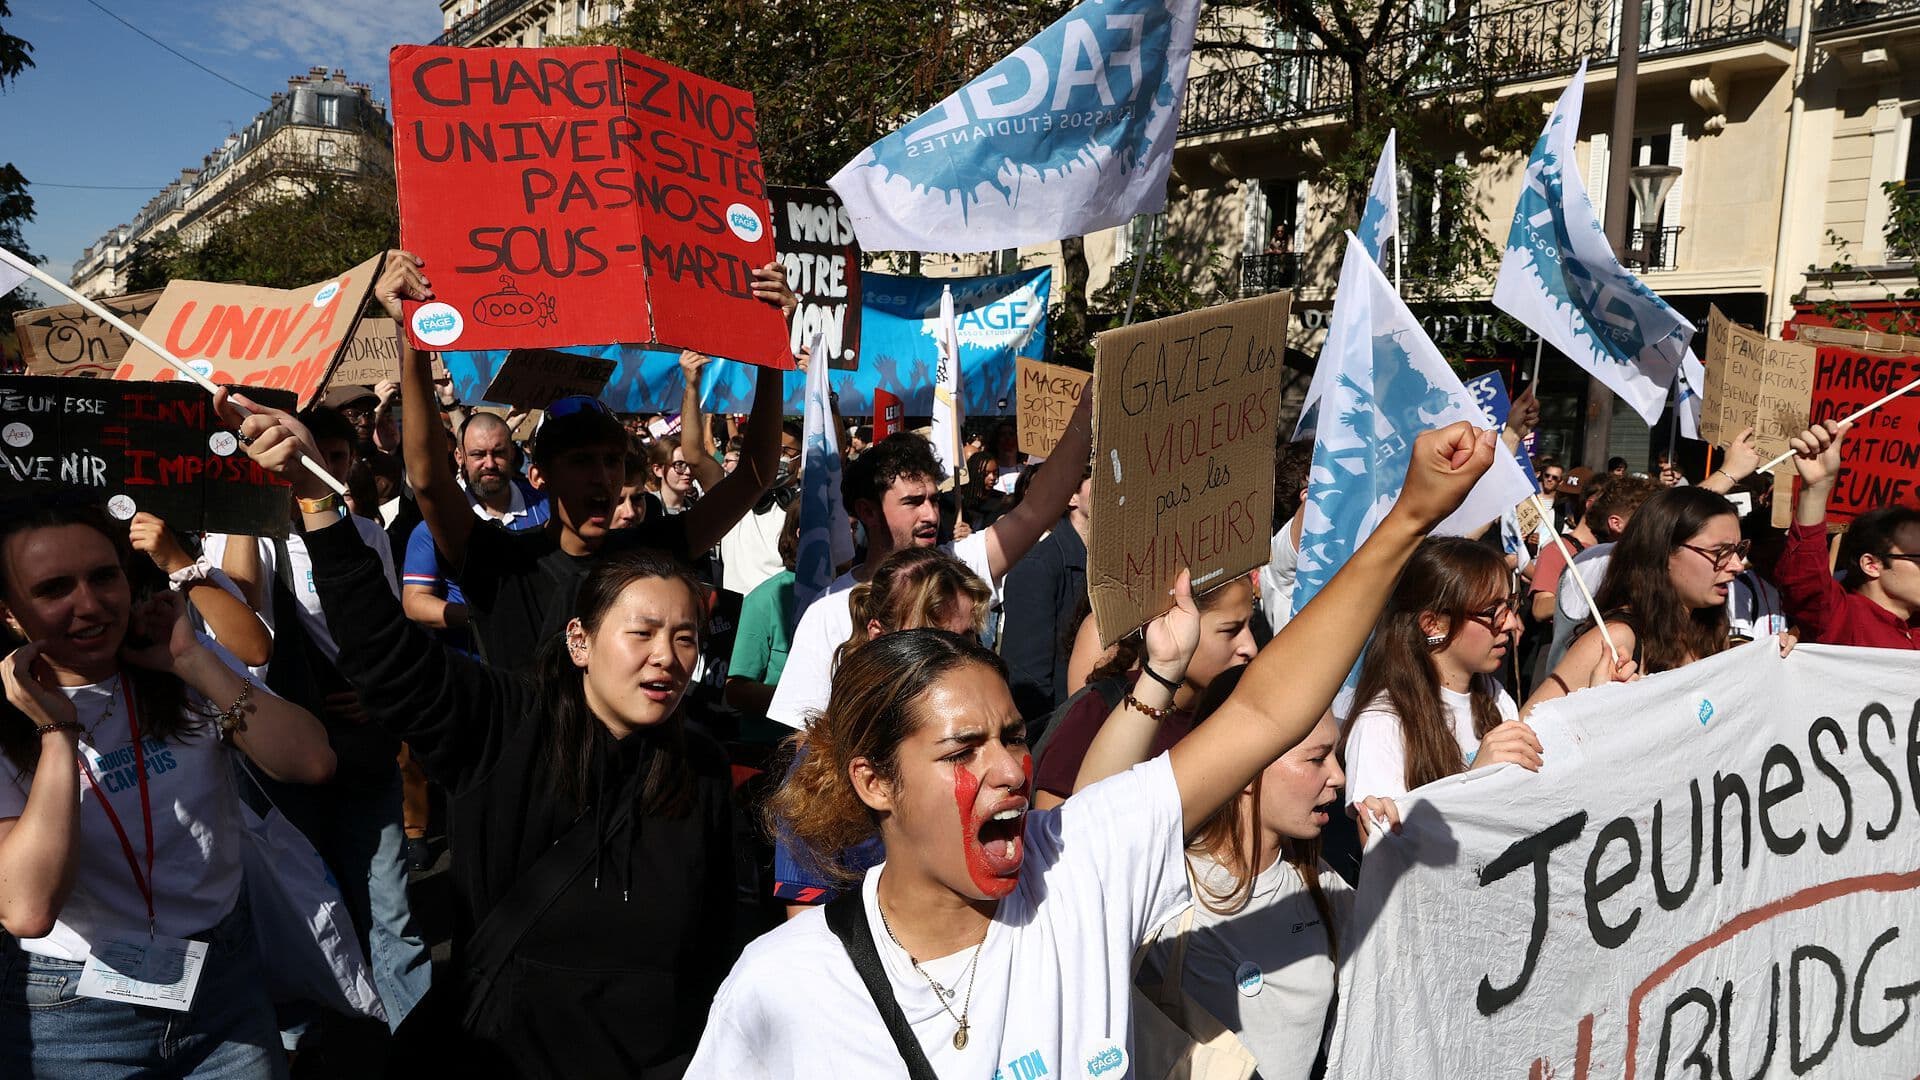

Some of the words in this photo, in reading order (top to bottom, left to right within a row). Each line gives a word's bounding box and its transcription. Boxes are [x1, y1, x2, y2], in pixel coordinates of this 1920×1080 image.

[412, 57, 671, 117] CHARGEZ
[678, 81, 758, 149] NOS
[410, 116, 767, 199] UNIVERSITÉS
[522, 167, 634, 215] PAS
[634, 174, 727, 235] NOS
[45, 325, 110, 364] On
[165, 301, 312, 360] UNIV
[423, 317, 453, 330] FAGE
[956, 300, 1031, 331] AGE
[1120, 325, 1233, 417] GAZEZ
[1240, 335, 1276, 378] les
[1732, 335, 1808, 375] PANCARTES
[1023, 394, 1067, 417] SORT
[1144, 387, 1273, 476] VIOLEURS
[1881, 415, 1901, 429] DE
[1156, 483, 1191, 536] pas
[1200, 456, 1231, 496] les
[1125, 490, 1258, 601] MINEURS
[1091, 1052, 1121, 1071] FAGE
